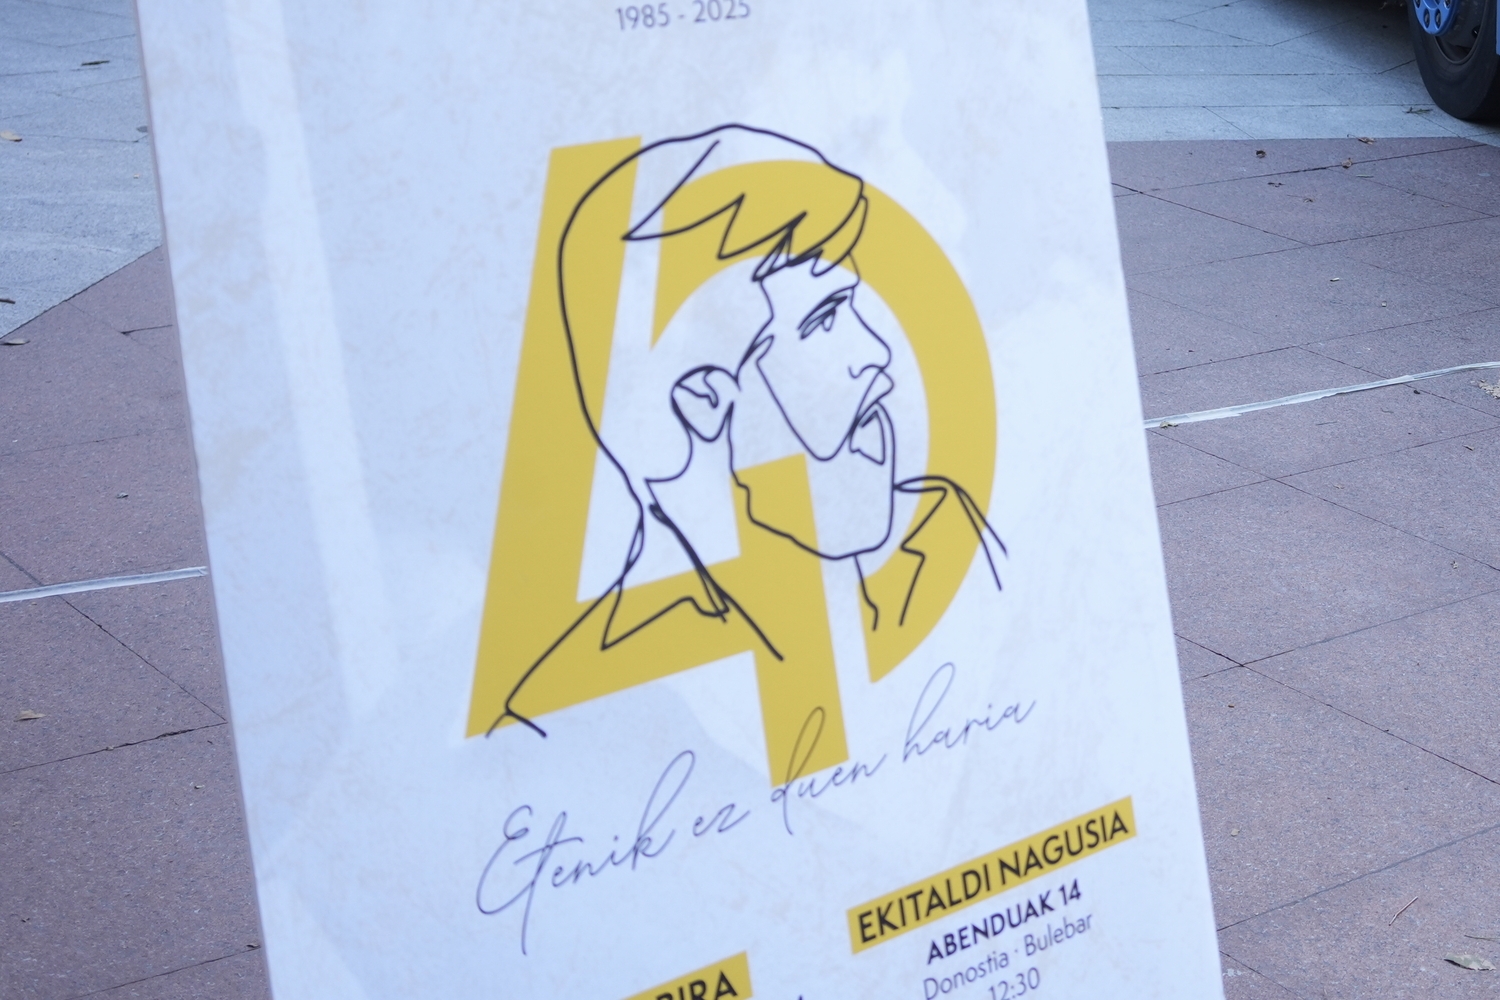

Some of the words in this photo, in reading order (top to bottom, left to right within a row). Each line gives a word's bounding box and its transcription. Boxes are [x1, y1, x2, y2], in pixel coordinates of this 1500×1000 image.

[615, 2, 670, 31] 1985
[476, 750, 696, 956] Etenik
[692, 802, 752, 838] ez
[771, 706, 886, 835] duen
[902, 662, 1038, 763] haria
[857, 861, 992, 945] EKITALDI
[997, 810, 1130, 887] NAGUSIA
[922, 949, 1010, 1000] Donostia
[1024, 913, 1094, 958] Bulebar
[926, 894, 1054, 965] ABENDUAK
[1058, 878, 1082, 906] 14
[987, 967, 1042, 1000] 12:30
